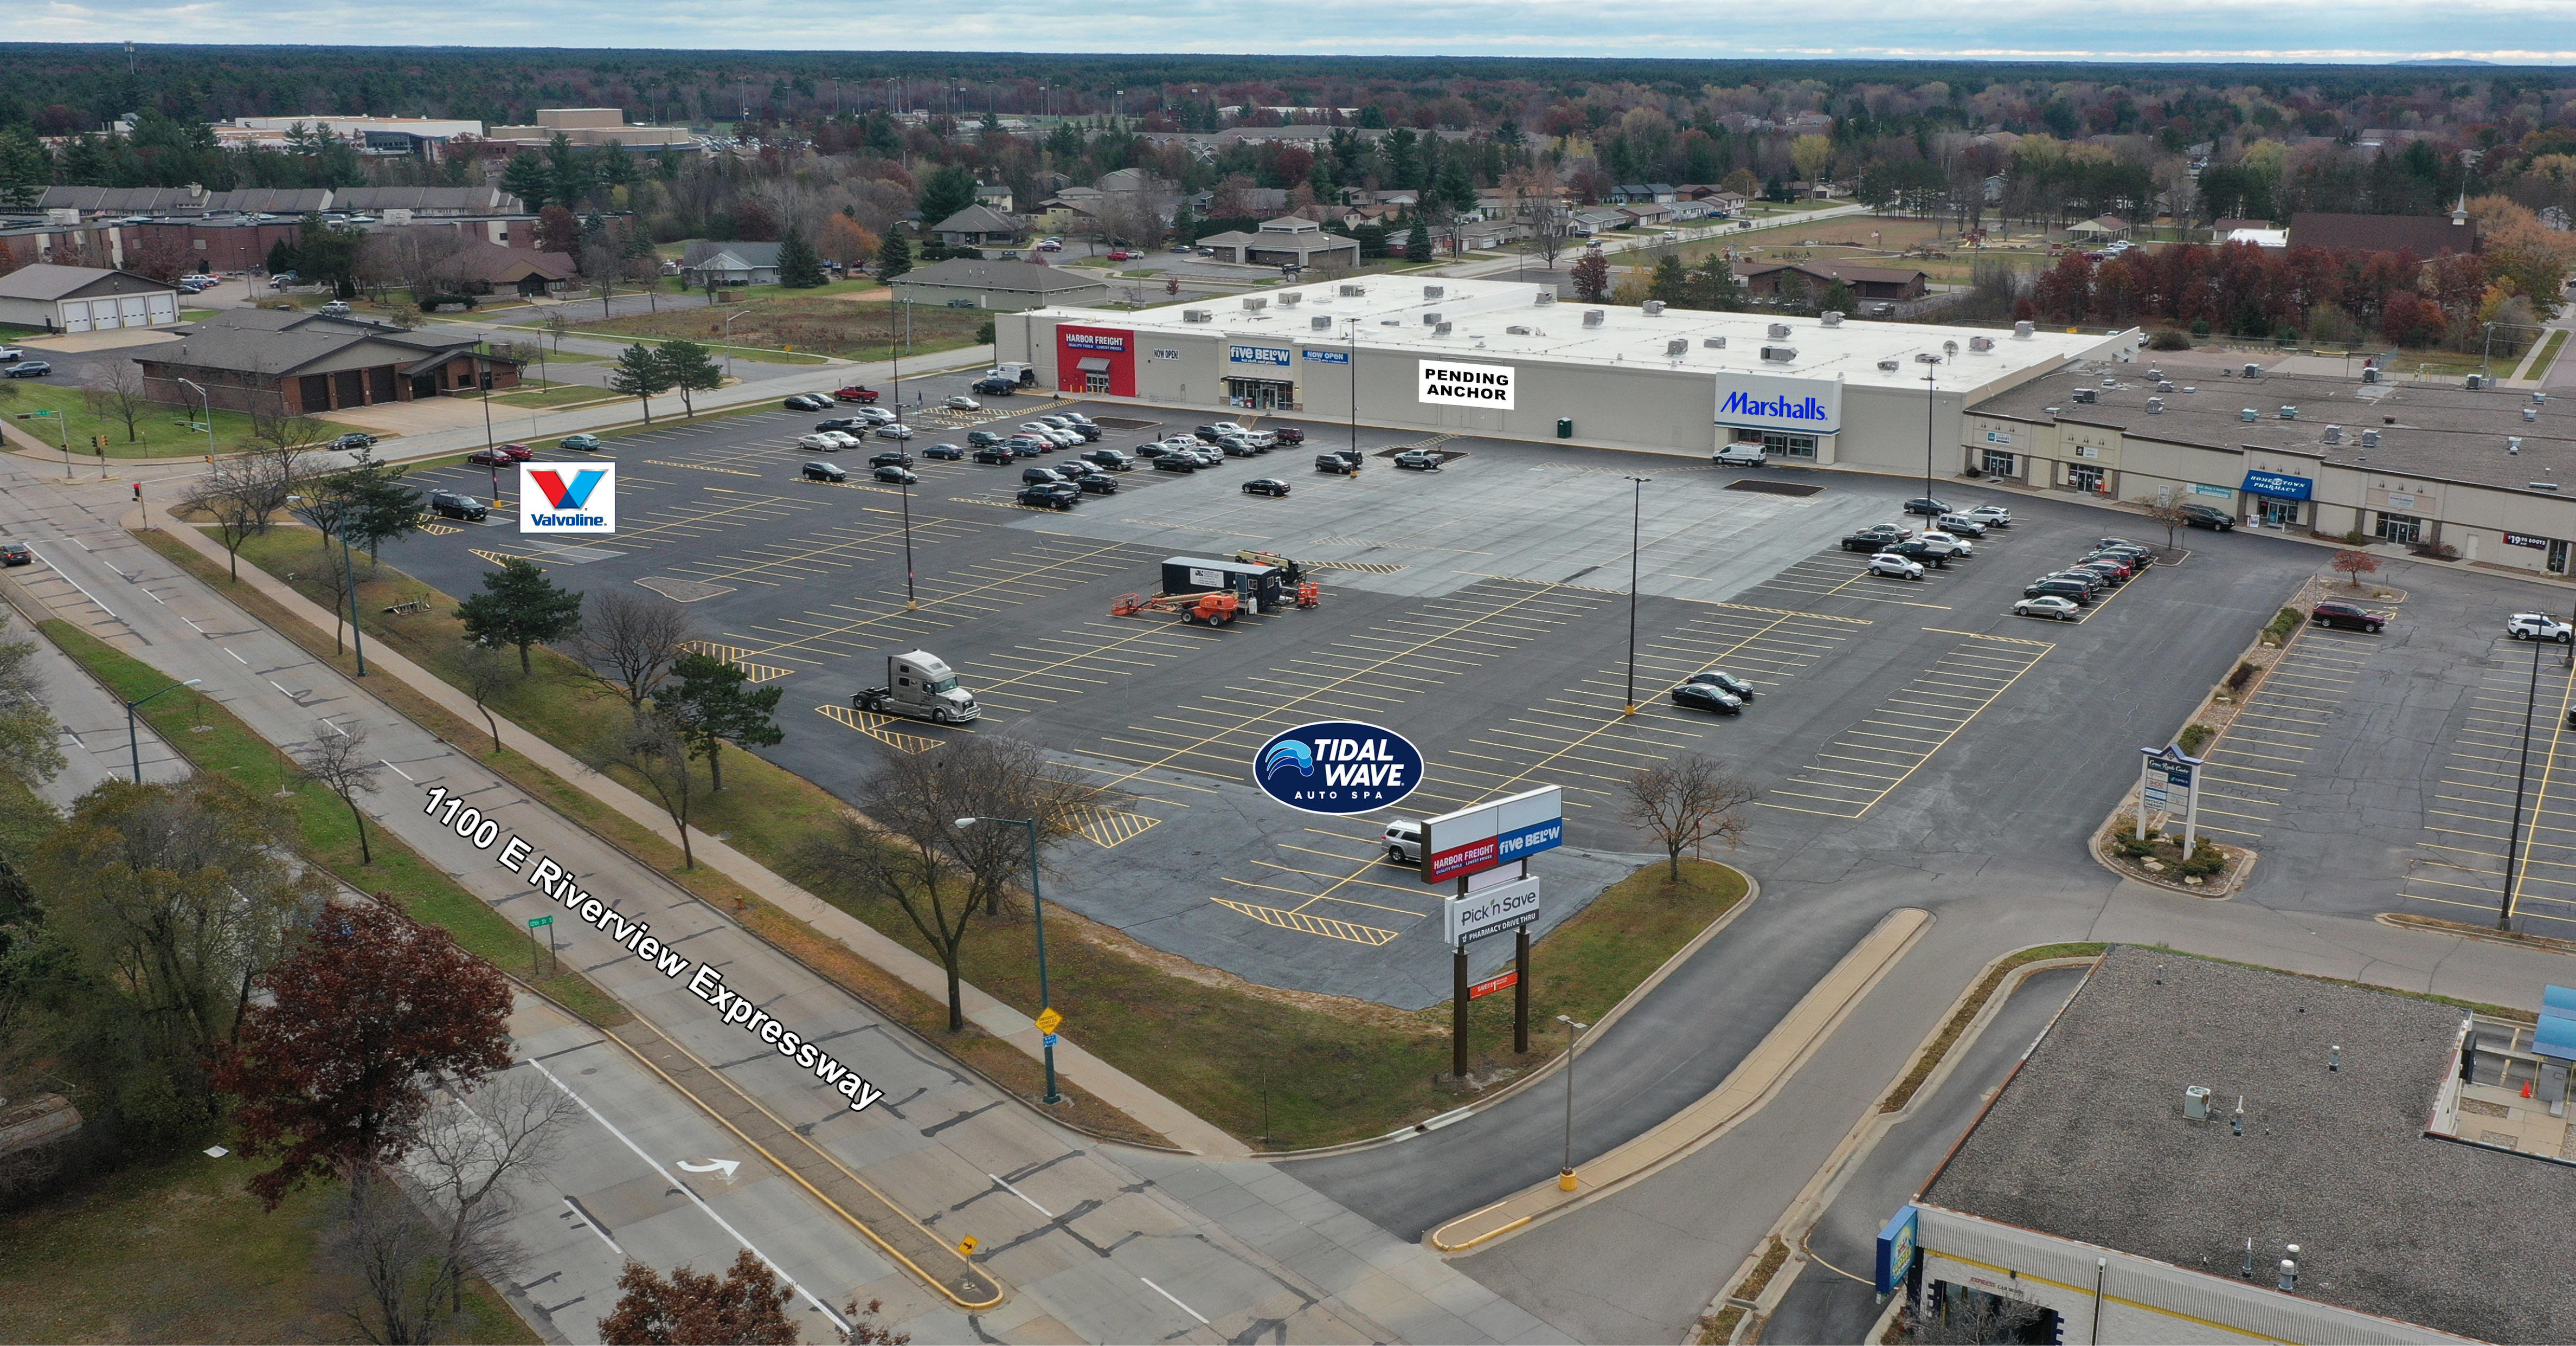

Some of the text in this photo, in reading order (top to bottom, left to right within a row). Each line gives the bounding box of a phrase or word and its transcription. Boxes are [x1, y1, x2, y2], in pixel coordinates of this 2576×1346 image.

[1066, 333, 1123, 346] HARBOR FREIGHT
[1154, 349, 1165, 358] NOW
[1720, 391, 1825, 420] Marshalls
[2254, 482, 2296, 493] PHARMACY
[1434, 844, 1494, 870] HARBOR FREIGHT
[1461, 905, 1489, 926] Pick
[1503, 892, 1536, 912] Save
[1469, 913, 1536, 941] PHARMACY DRIVE THRU
